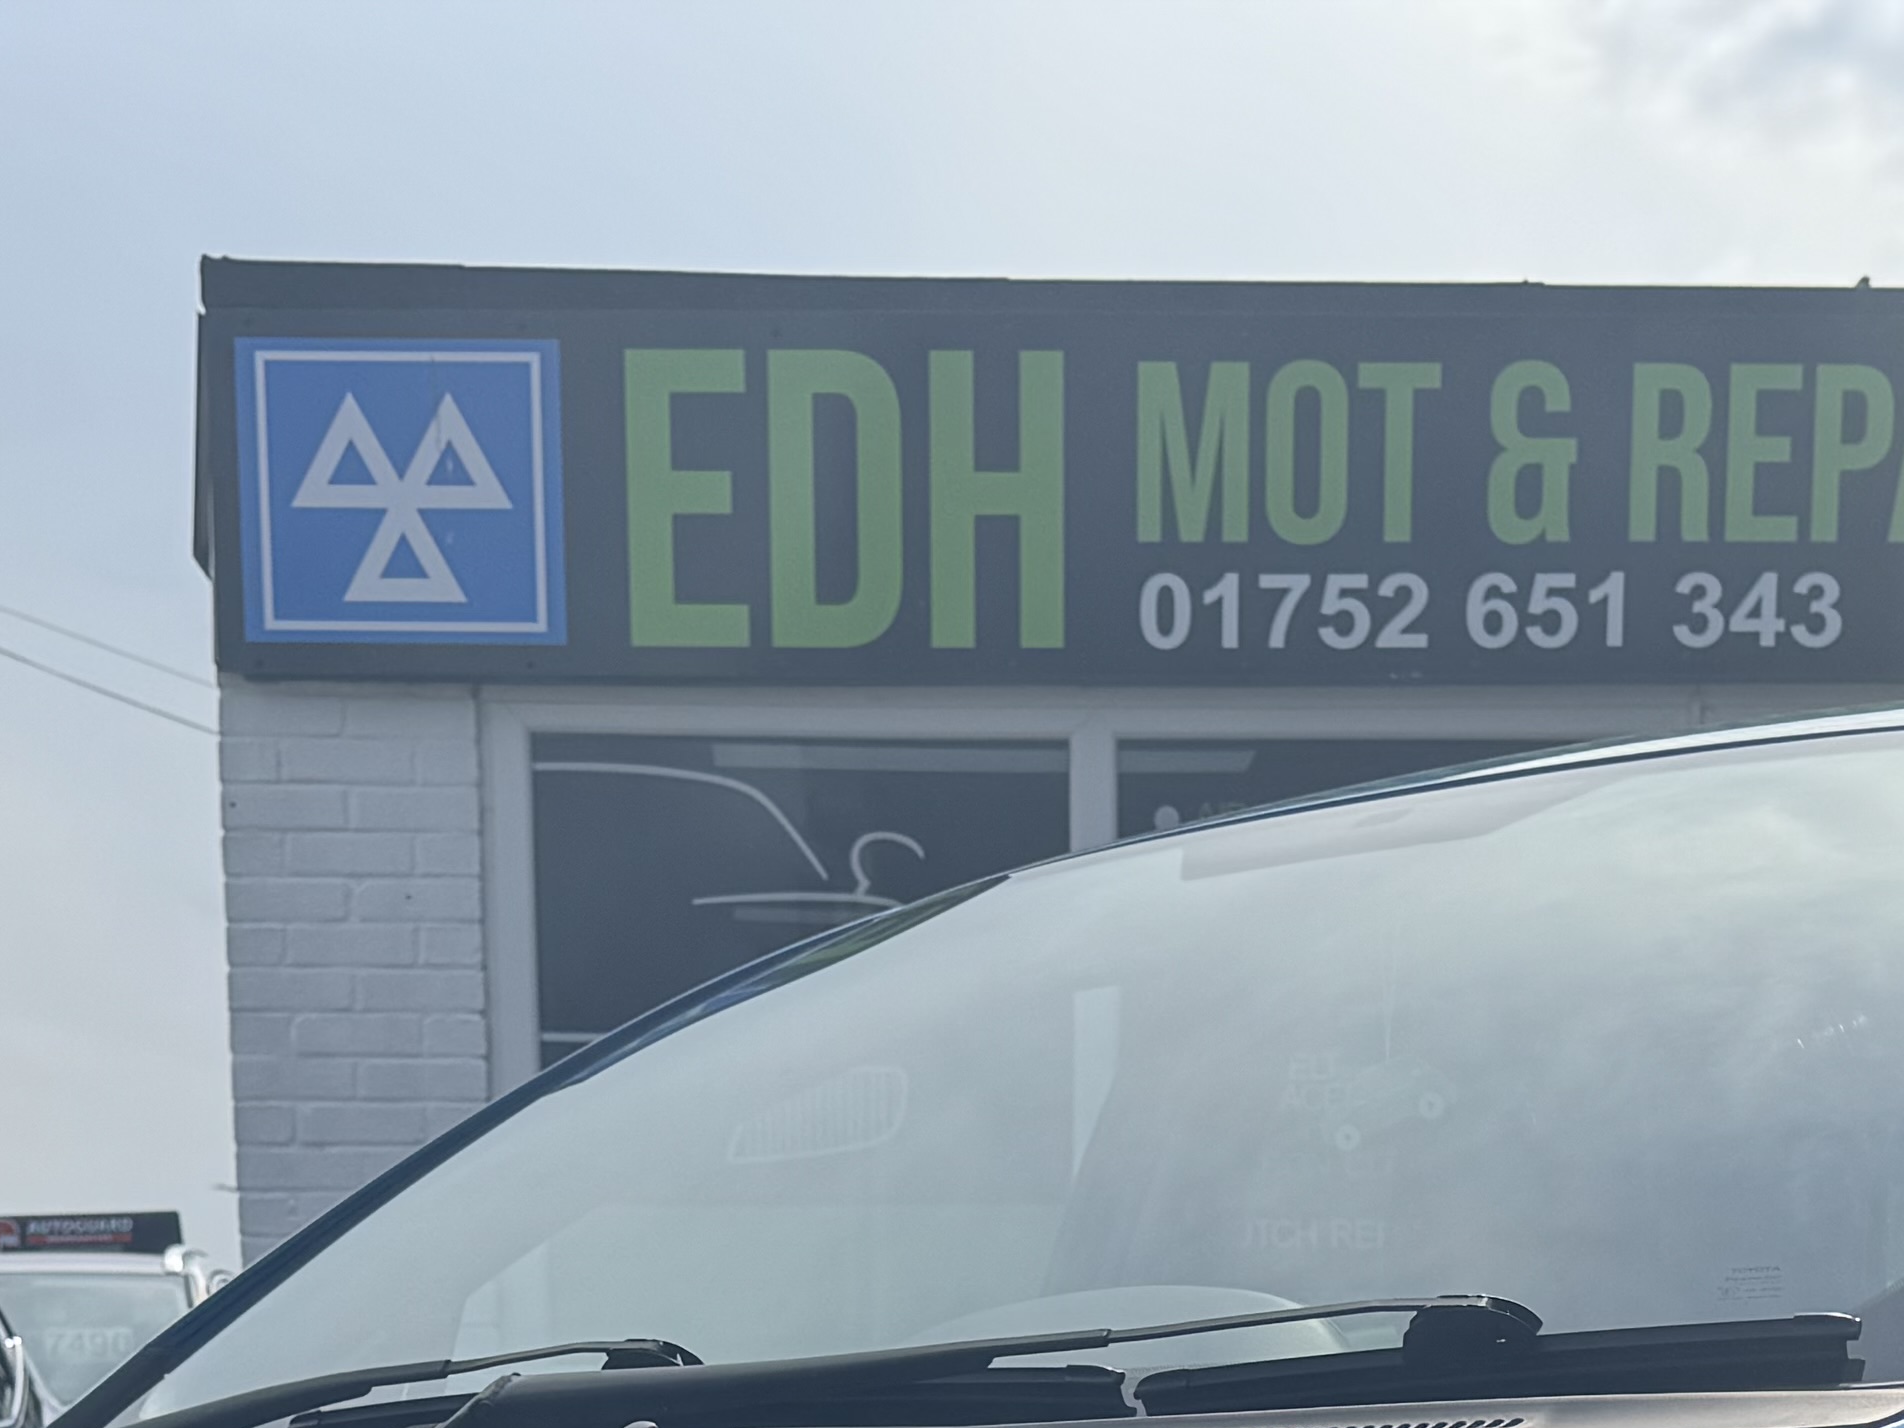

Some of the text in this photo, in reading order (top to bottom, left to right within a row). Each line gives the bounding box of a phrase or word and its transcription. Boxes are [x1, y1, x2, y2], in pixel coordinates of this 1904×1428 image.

[623, 348, 1065, 651] EDH
[1136, 361, 1441, 546] MOT
[1486, 361, 1578, 546] &
[1140, 571, 1843, 649] 01752 651 343
